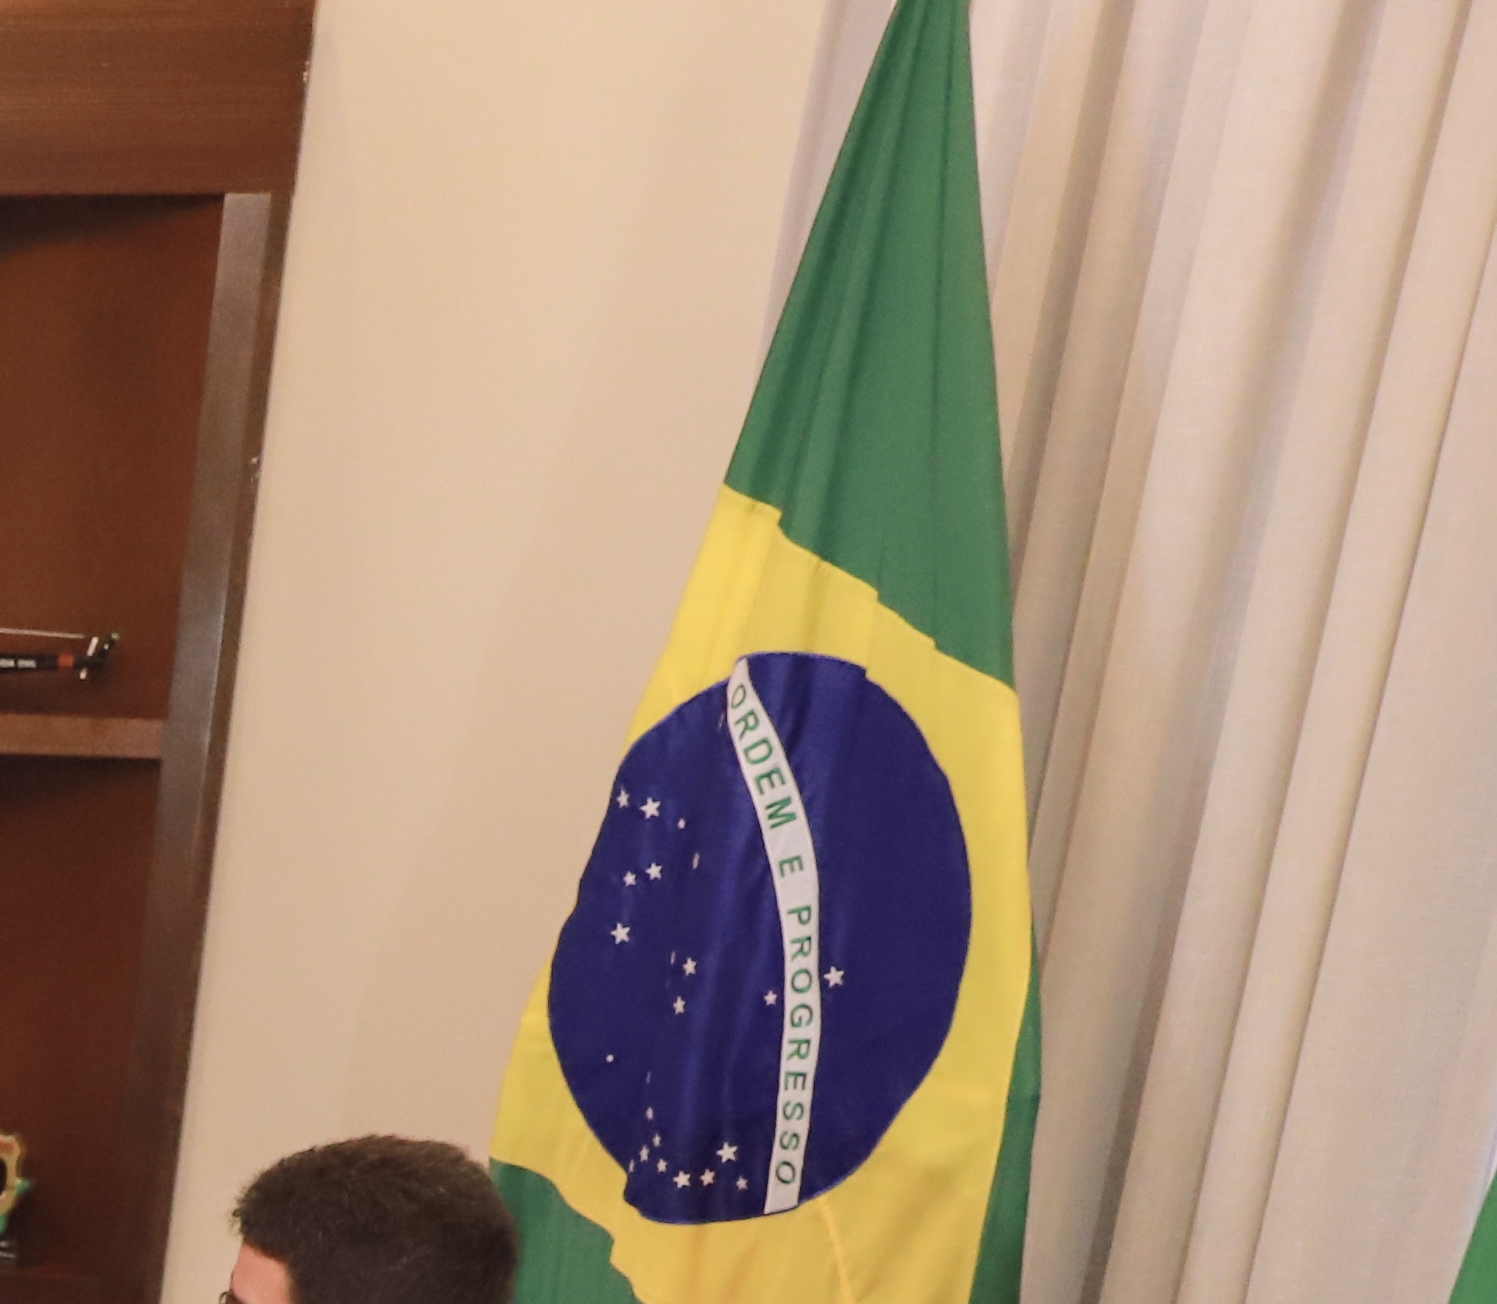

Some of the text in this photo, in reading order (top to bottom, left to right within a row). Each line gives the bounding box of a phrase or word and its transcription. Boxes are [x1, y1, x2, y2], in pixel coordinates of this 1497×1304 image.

[730, 685, 813, 1184] ORDEM E PROGRESSO
